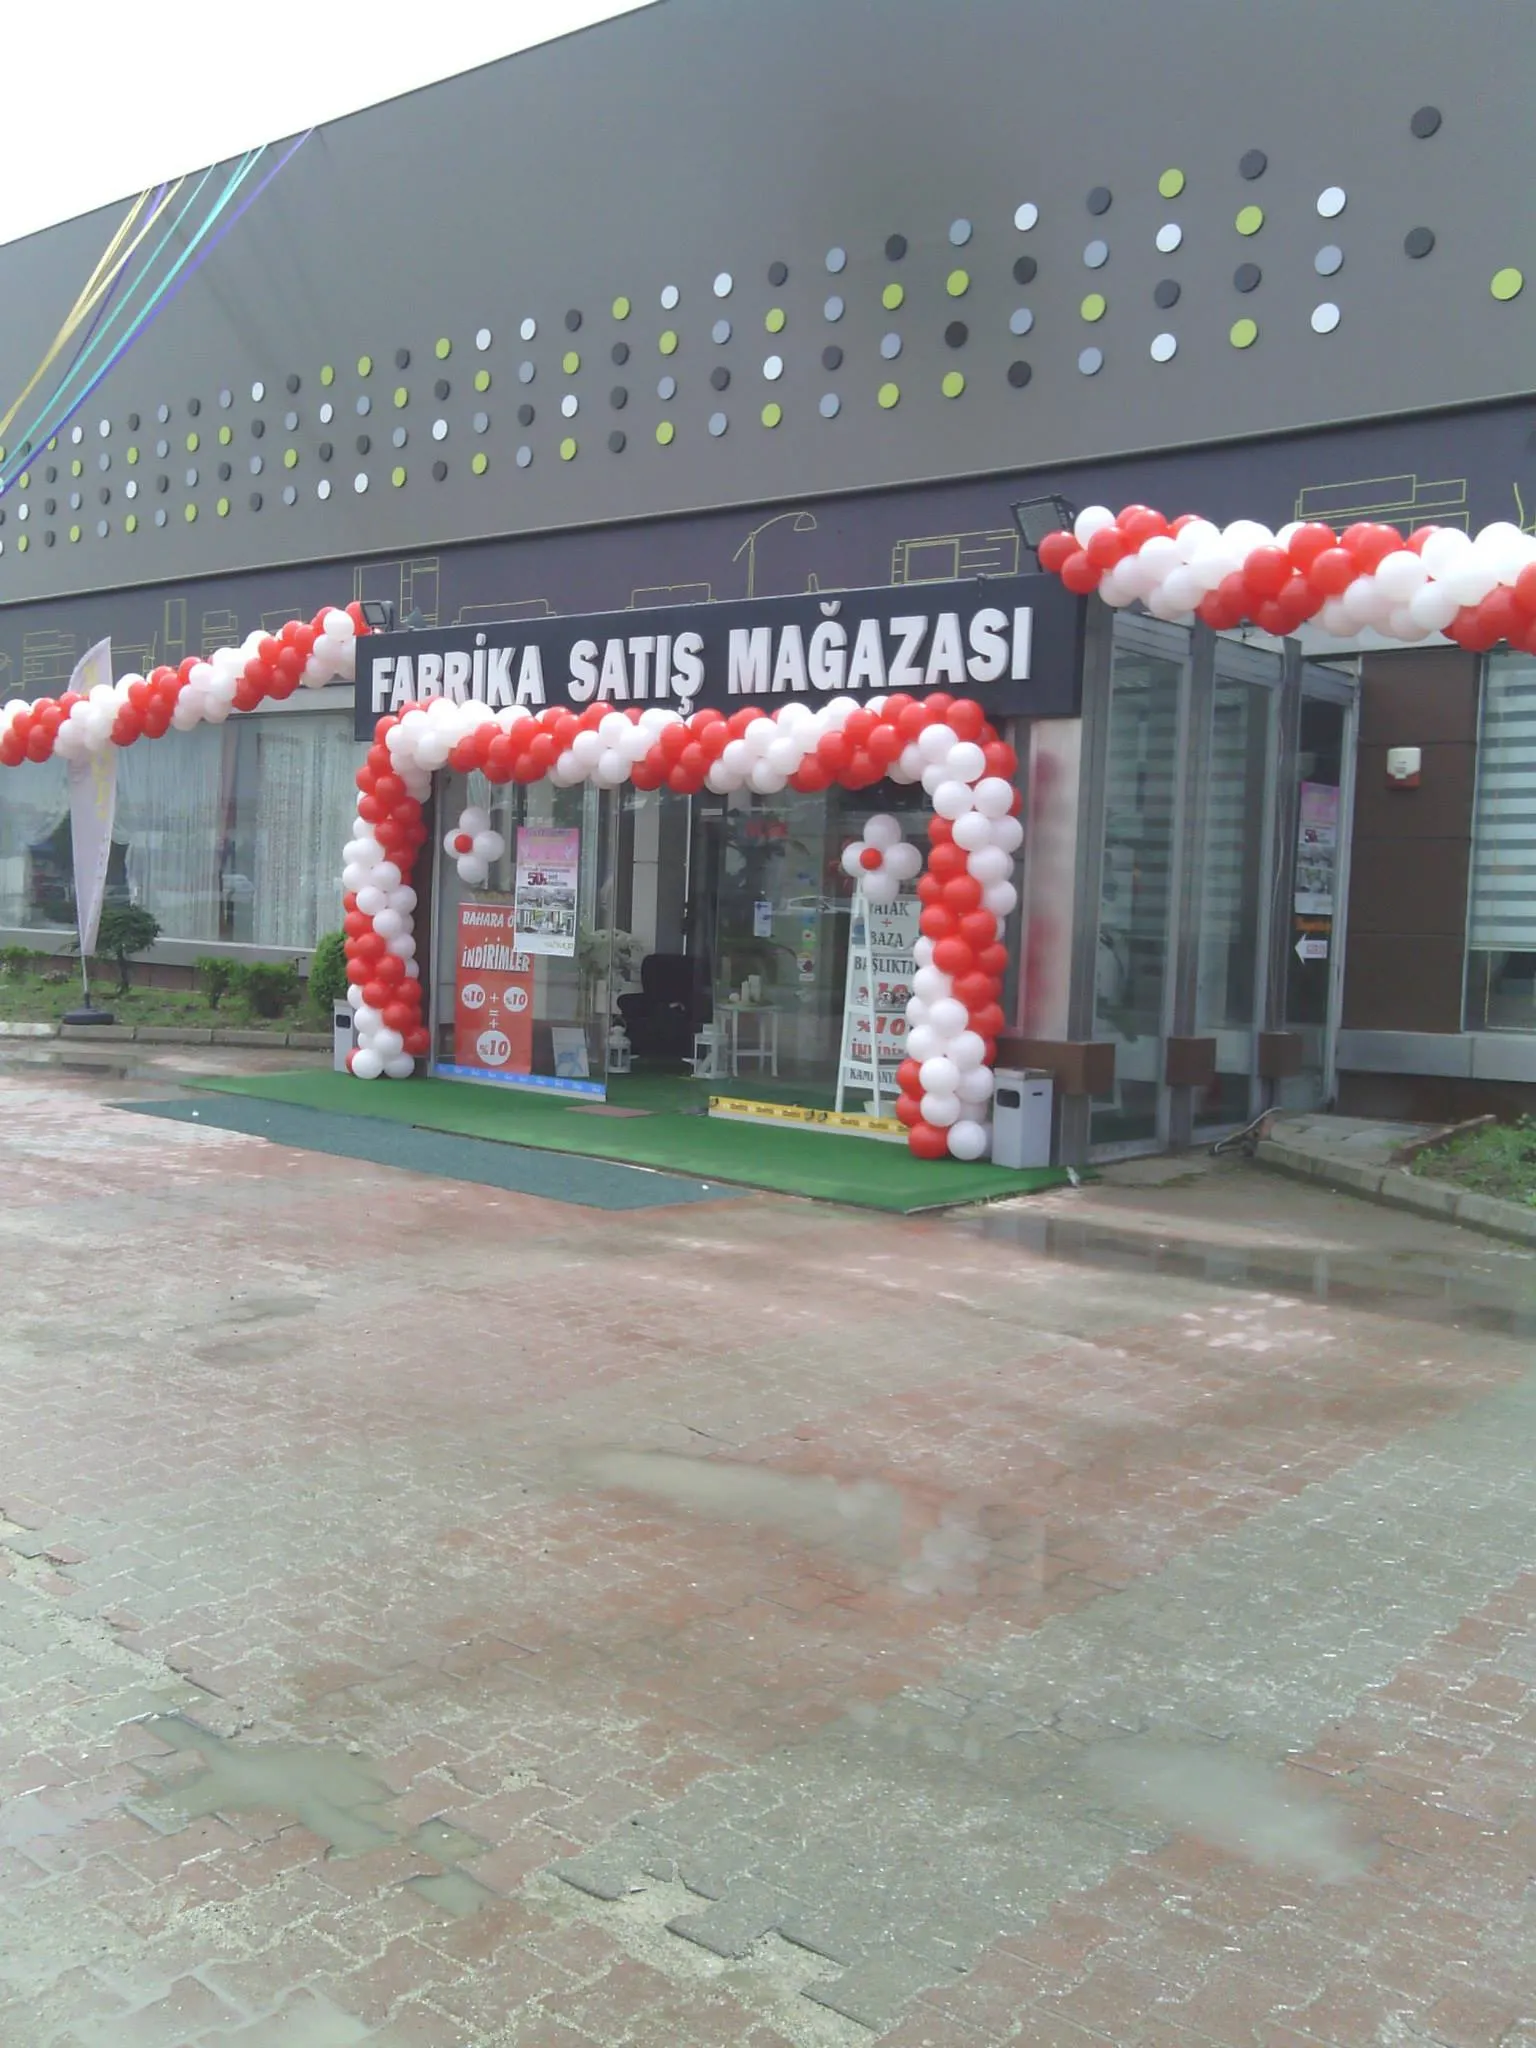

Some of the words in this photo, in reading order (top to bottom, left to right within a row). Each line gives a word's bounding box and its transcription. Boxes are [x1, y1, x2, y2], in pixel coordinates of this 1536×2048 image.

[372, 633, 546, 713] FABRİKA
[567, 632, 705, 715] SATIŞ
[727, 600, 1033, 695] MAĞAZASI
[462, 911, 504, 927] BAHARA
[870, 931, 904, 947] BAZA
